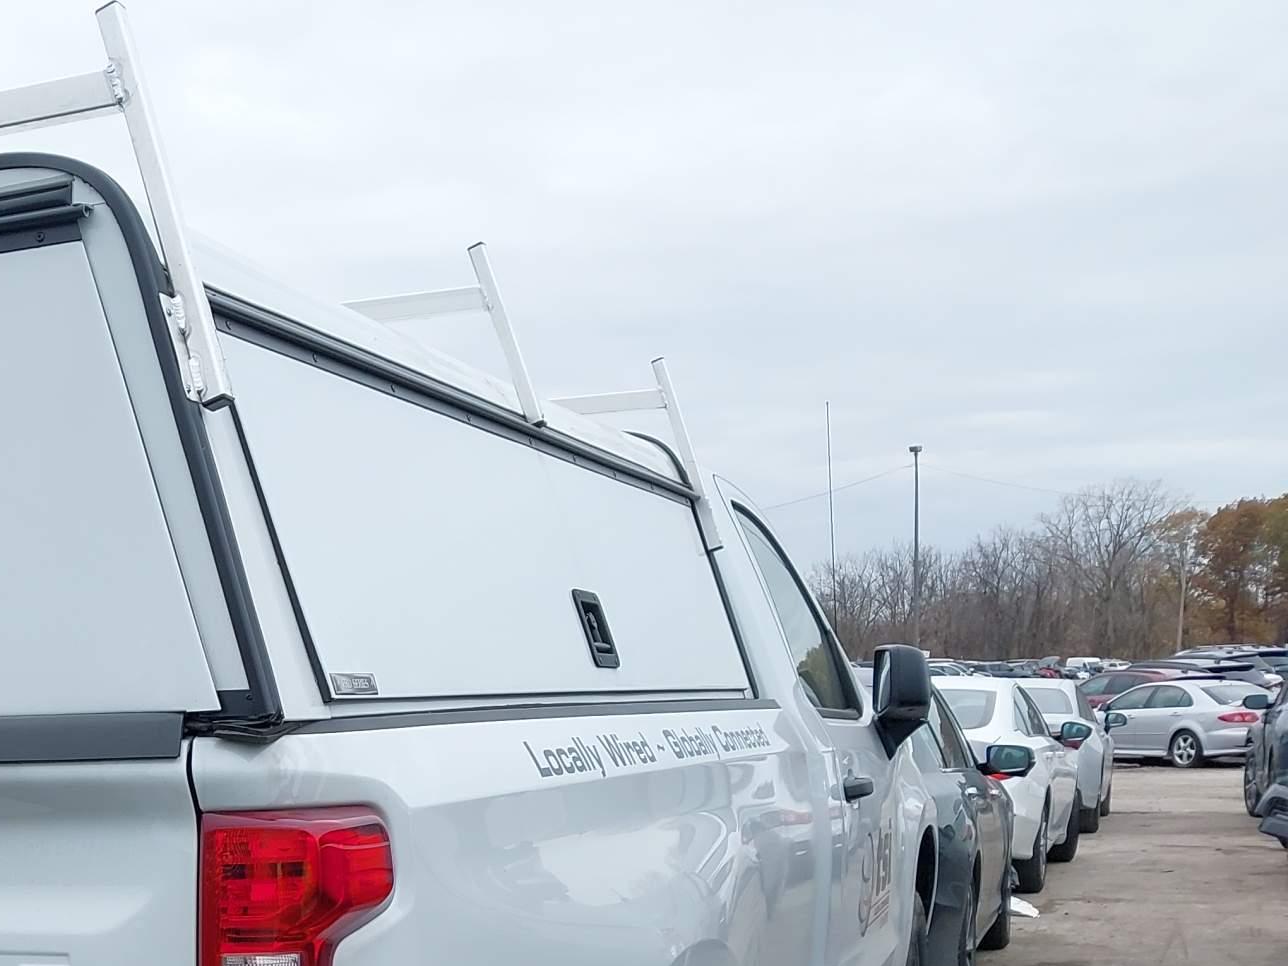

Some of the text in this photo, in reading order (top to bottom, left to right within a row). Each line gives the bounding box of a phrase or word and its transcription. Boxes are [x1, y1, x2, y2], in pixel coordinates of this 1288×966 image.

[523, 736, 607, 778] Locally
[596, 731, 658, 768] Wired
[662, 727, 721, 761] Globally
[712, 722, 772, 752] Connected
